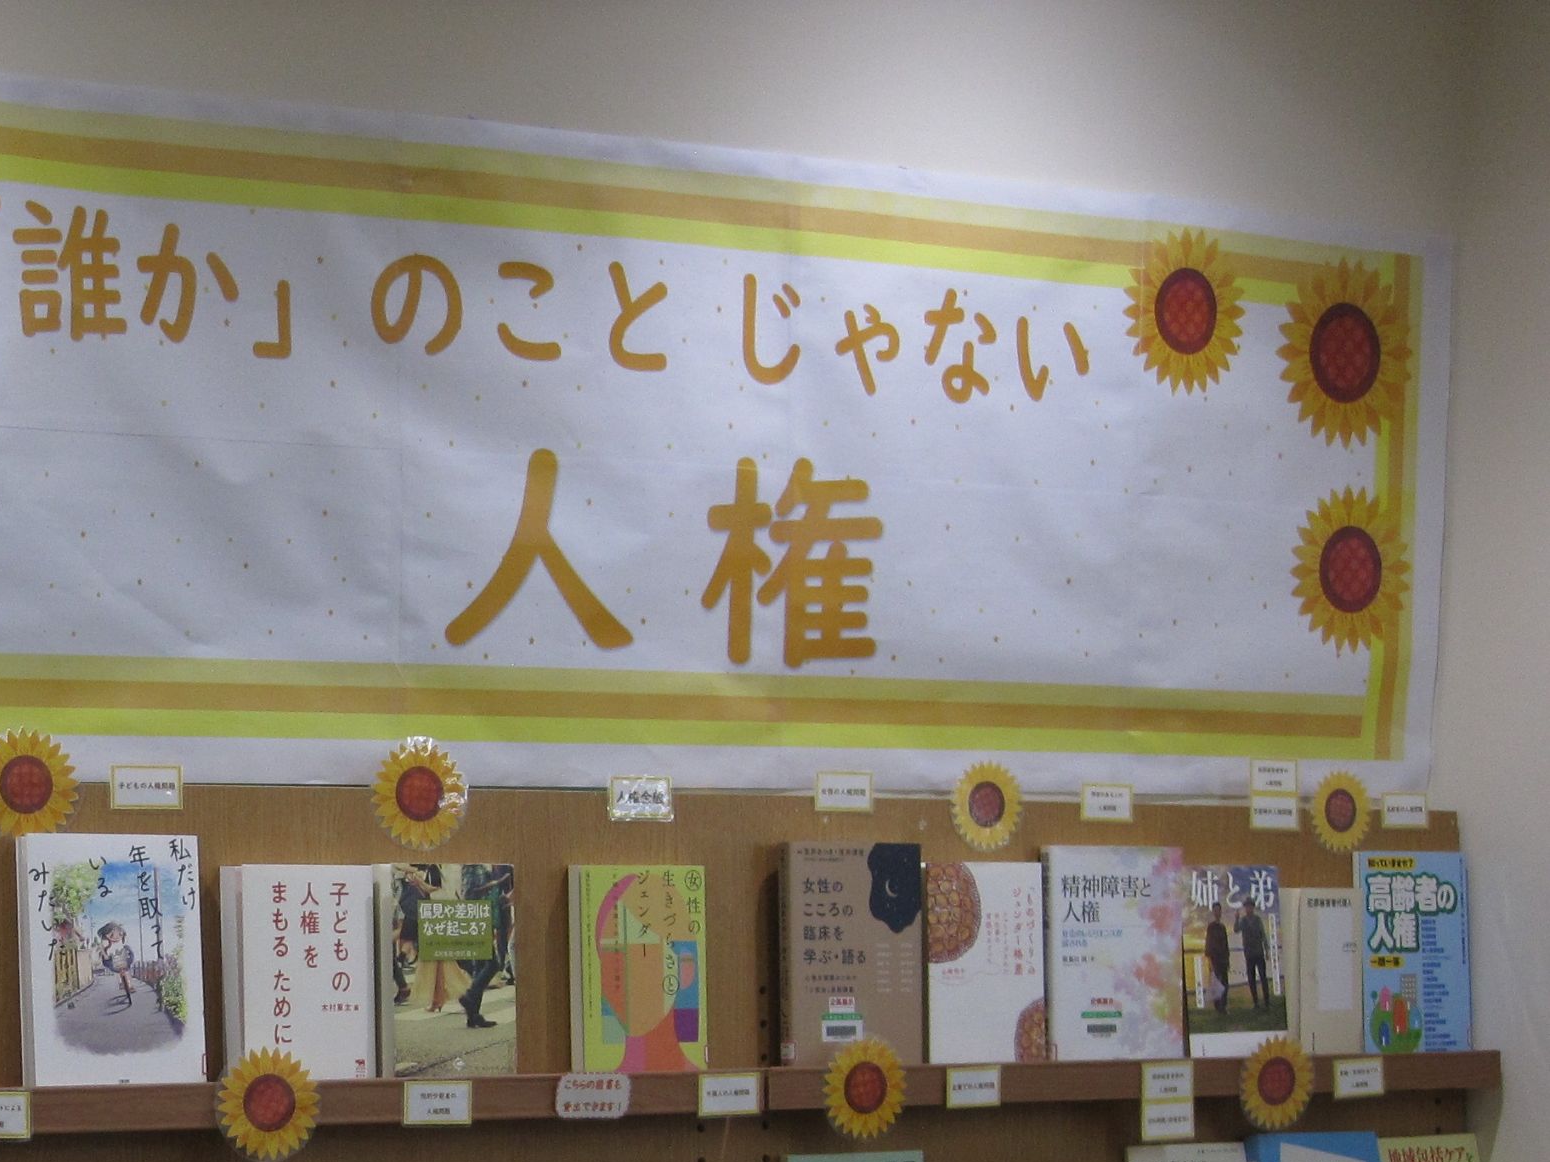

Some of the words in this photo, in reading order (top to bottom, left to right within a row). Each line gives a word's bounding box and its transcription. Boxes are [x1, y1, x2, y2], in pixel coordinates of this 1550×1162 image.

[444, 448, 884, 668] 人権
[117, 780, 177, 792] 子どもの人権問題
[88, 856, 113, 899] いる
[168, 837, 197, 911] 私だけ
[802, 877, 844, 895] 女性の
[1061, 874, 1152, 899] 精神障害と
[1190, 870, 1276, 913] 姉と弟
[1366, 872, 1456, 913] 高齢者の
[29, 863, 67, 962] みたいだ
[128, 843, 164, 960] 年を取って
[419, 901, 491, 920] 偏見や差別は
[638, 869, 652, 958] ジェンダー
[684, 869, 703, 936] 女性の
[802, 901, 854, 918] こころの
[1063, 901, 1101, 925] 人権
[300, 881, 320, 970] 人権を
[329, 881, 351, 993] 子どもの
[423, 921, 487, 938] なぜ起こる?
[661, 870, 680, 996] 生きづらさと
[802, 925, 844, 942] 臨床を
[1371, 912, 1419, 952] 人権
[271, 880, 293, 1045] まもるために
[802, 949, 867, 966] 学ぶ・語る
